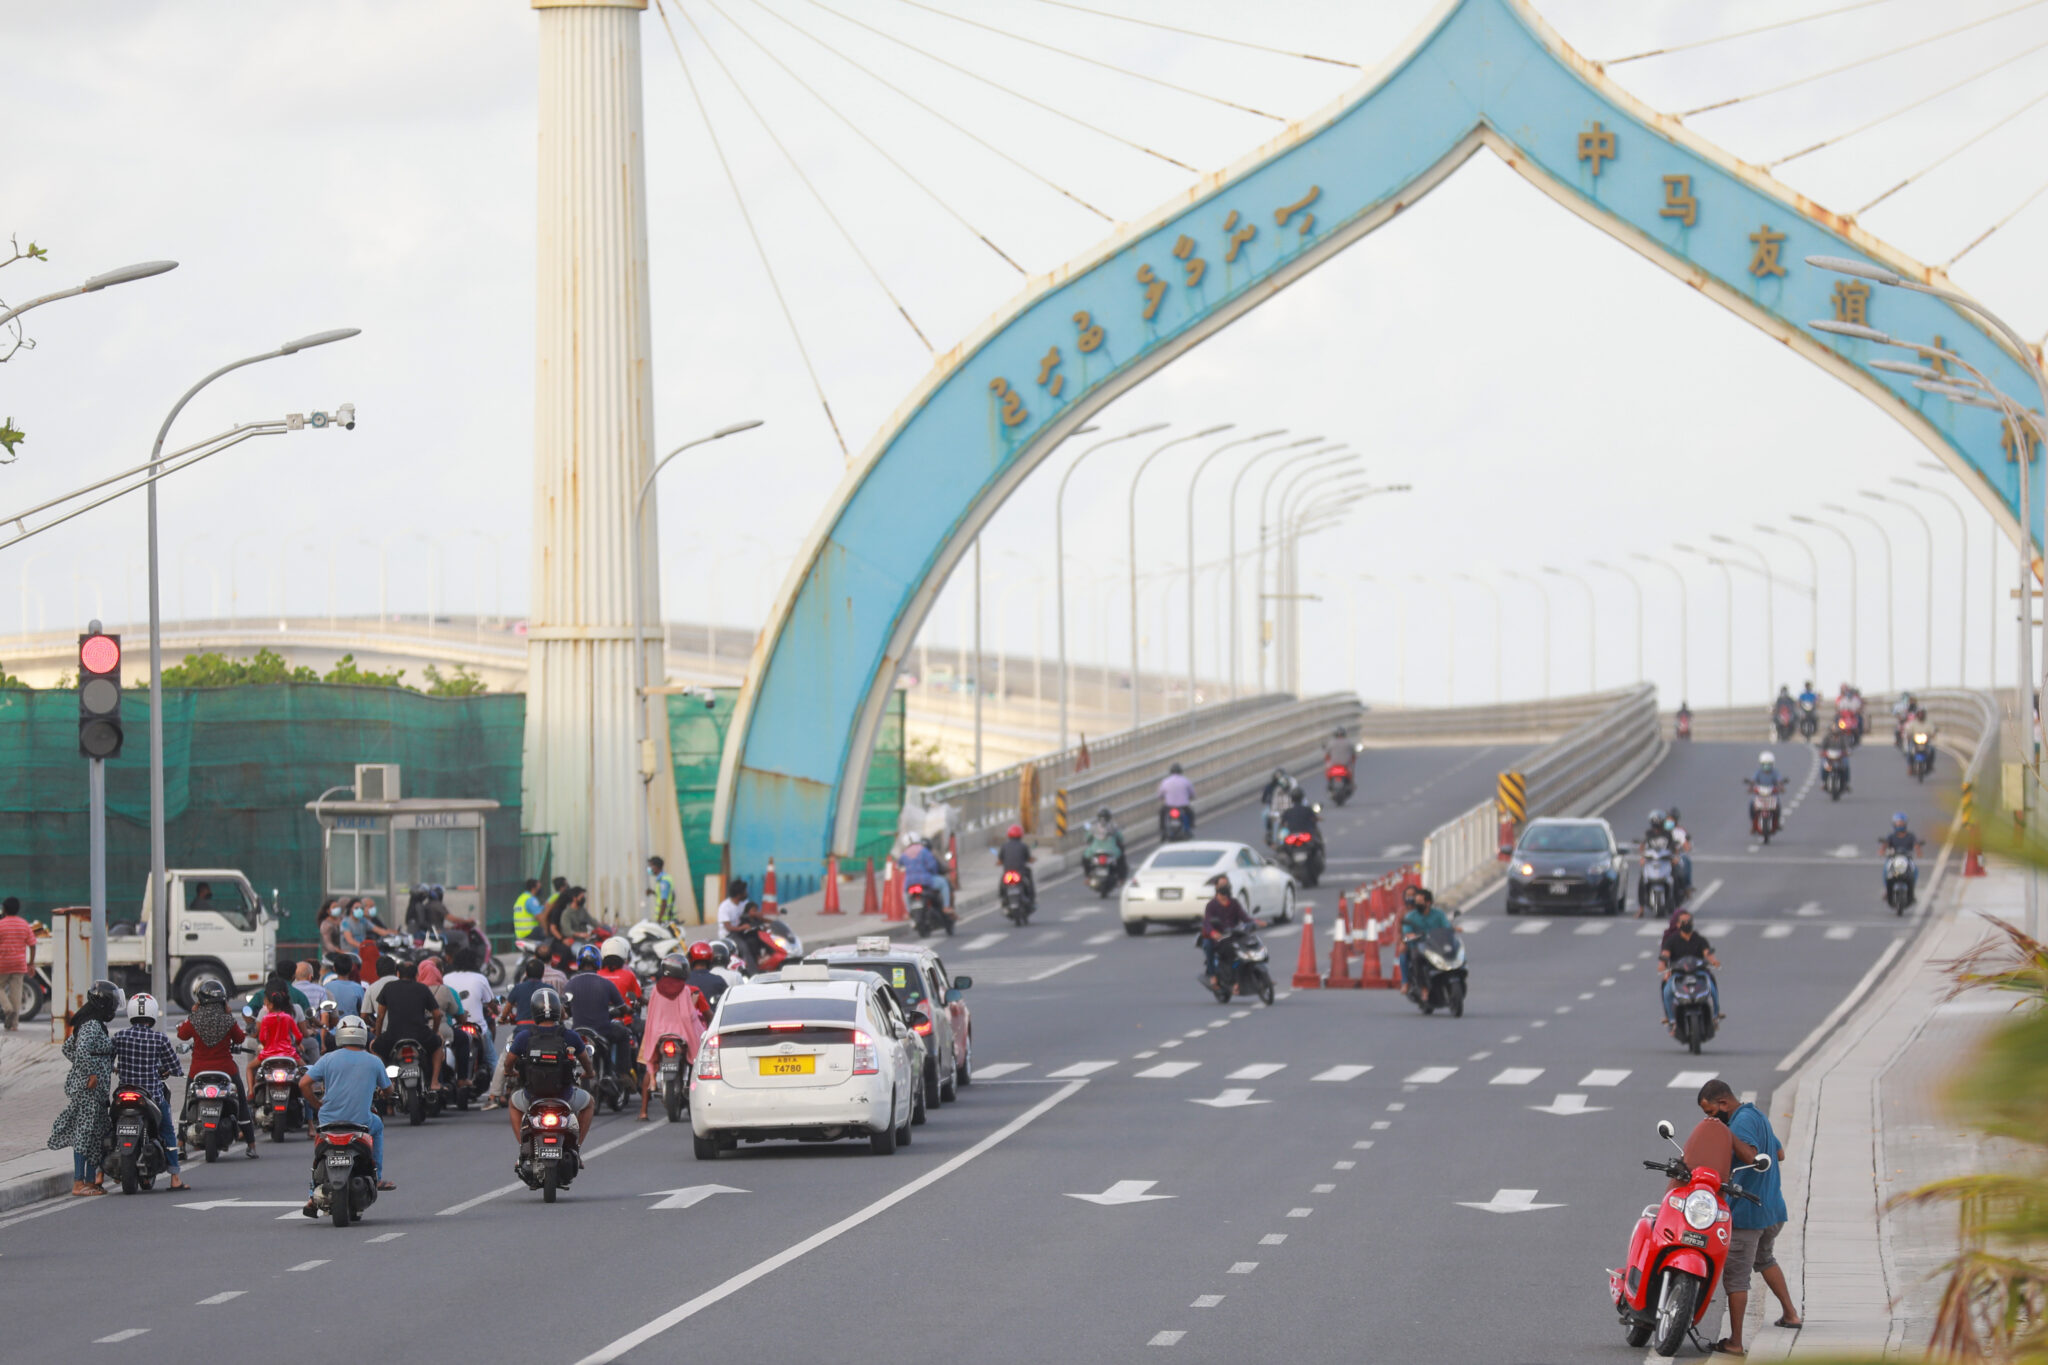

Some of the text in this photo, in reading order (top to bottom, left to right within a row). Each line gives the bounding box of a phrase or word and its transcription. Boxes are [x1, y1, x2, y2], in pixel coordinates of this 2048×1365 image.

[337, 816, 377, 828] POLICE
[416, 813, 460, 827] POLICE
[243, 939, 254, 947] 2T
[774, 1064, 802, 1073] T4780
